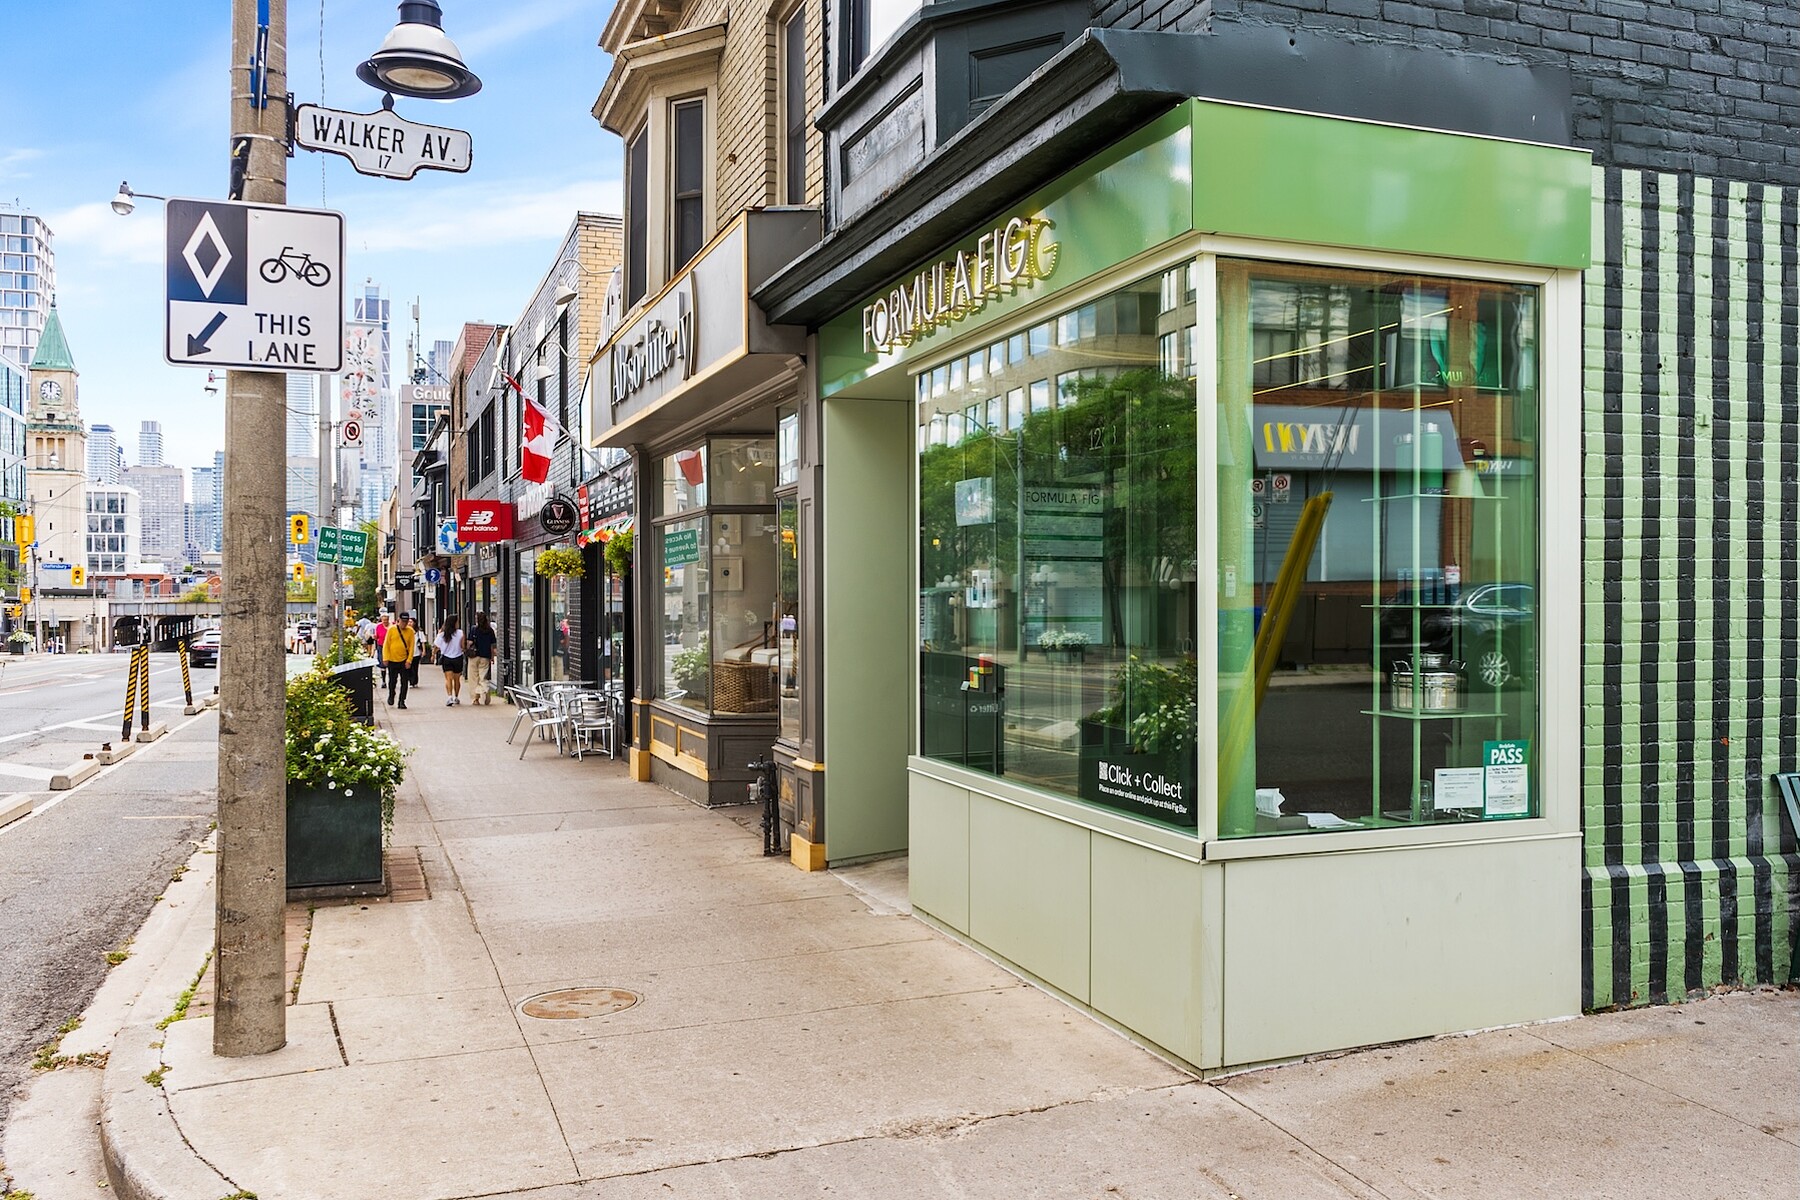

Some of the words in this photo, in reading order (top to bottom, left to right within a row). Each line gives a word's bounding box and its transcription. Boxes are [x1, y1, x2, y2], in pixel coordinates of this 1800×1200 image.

[313, 114, 404, 154] WALKER
[421, 133, 457, 163] AV.
[378, 155, 392, 170] 17
[862, 250, 975, 354] FORMULA
[978, 216, 1029, 295] FIG
[255, 312, 311, 337] THIS
[248, 340, 317, 365] LANE
[1025, 491, 1077, 504] FORMULA
[1082, 493, 1100, 504] FIG
[325, 530, 336, 538] No
[341, 533, 361, 542] ccess
[318, 551, 333, 559] from
[328, 542, 353, 552] Avnue
[354, 545, 363, 553] Rd
[1491, 748, 1523, 764] PASS
[1108, 764, 1132, 787] Click
[1142, 772, 1183, 800] Collect
[1098, 783, 1110, 794] Place
[1114, 788, 1125, 797] order
[1125, 791, 1137, 800] online
[1136, 795, 1145, 803] and
[1164, 801, 1172, 810] this
